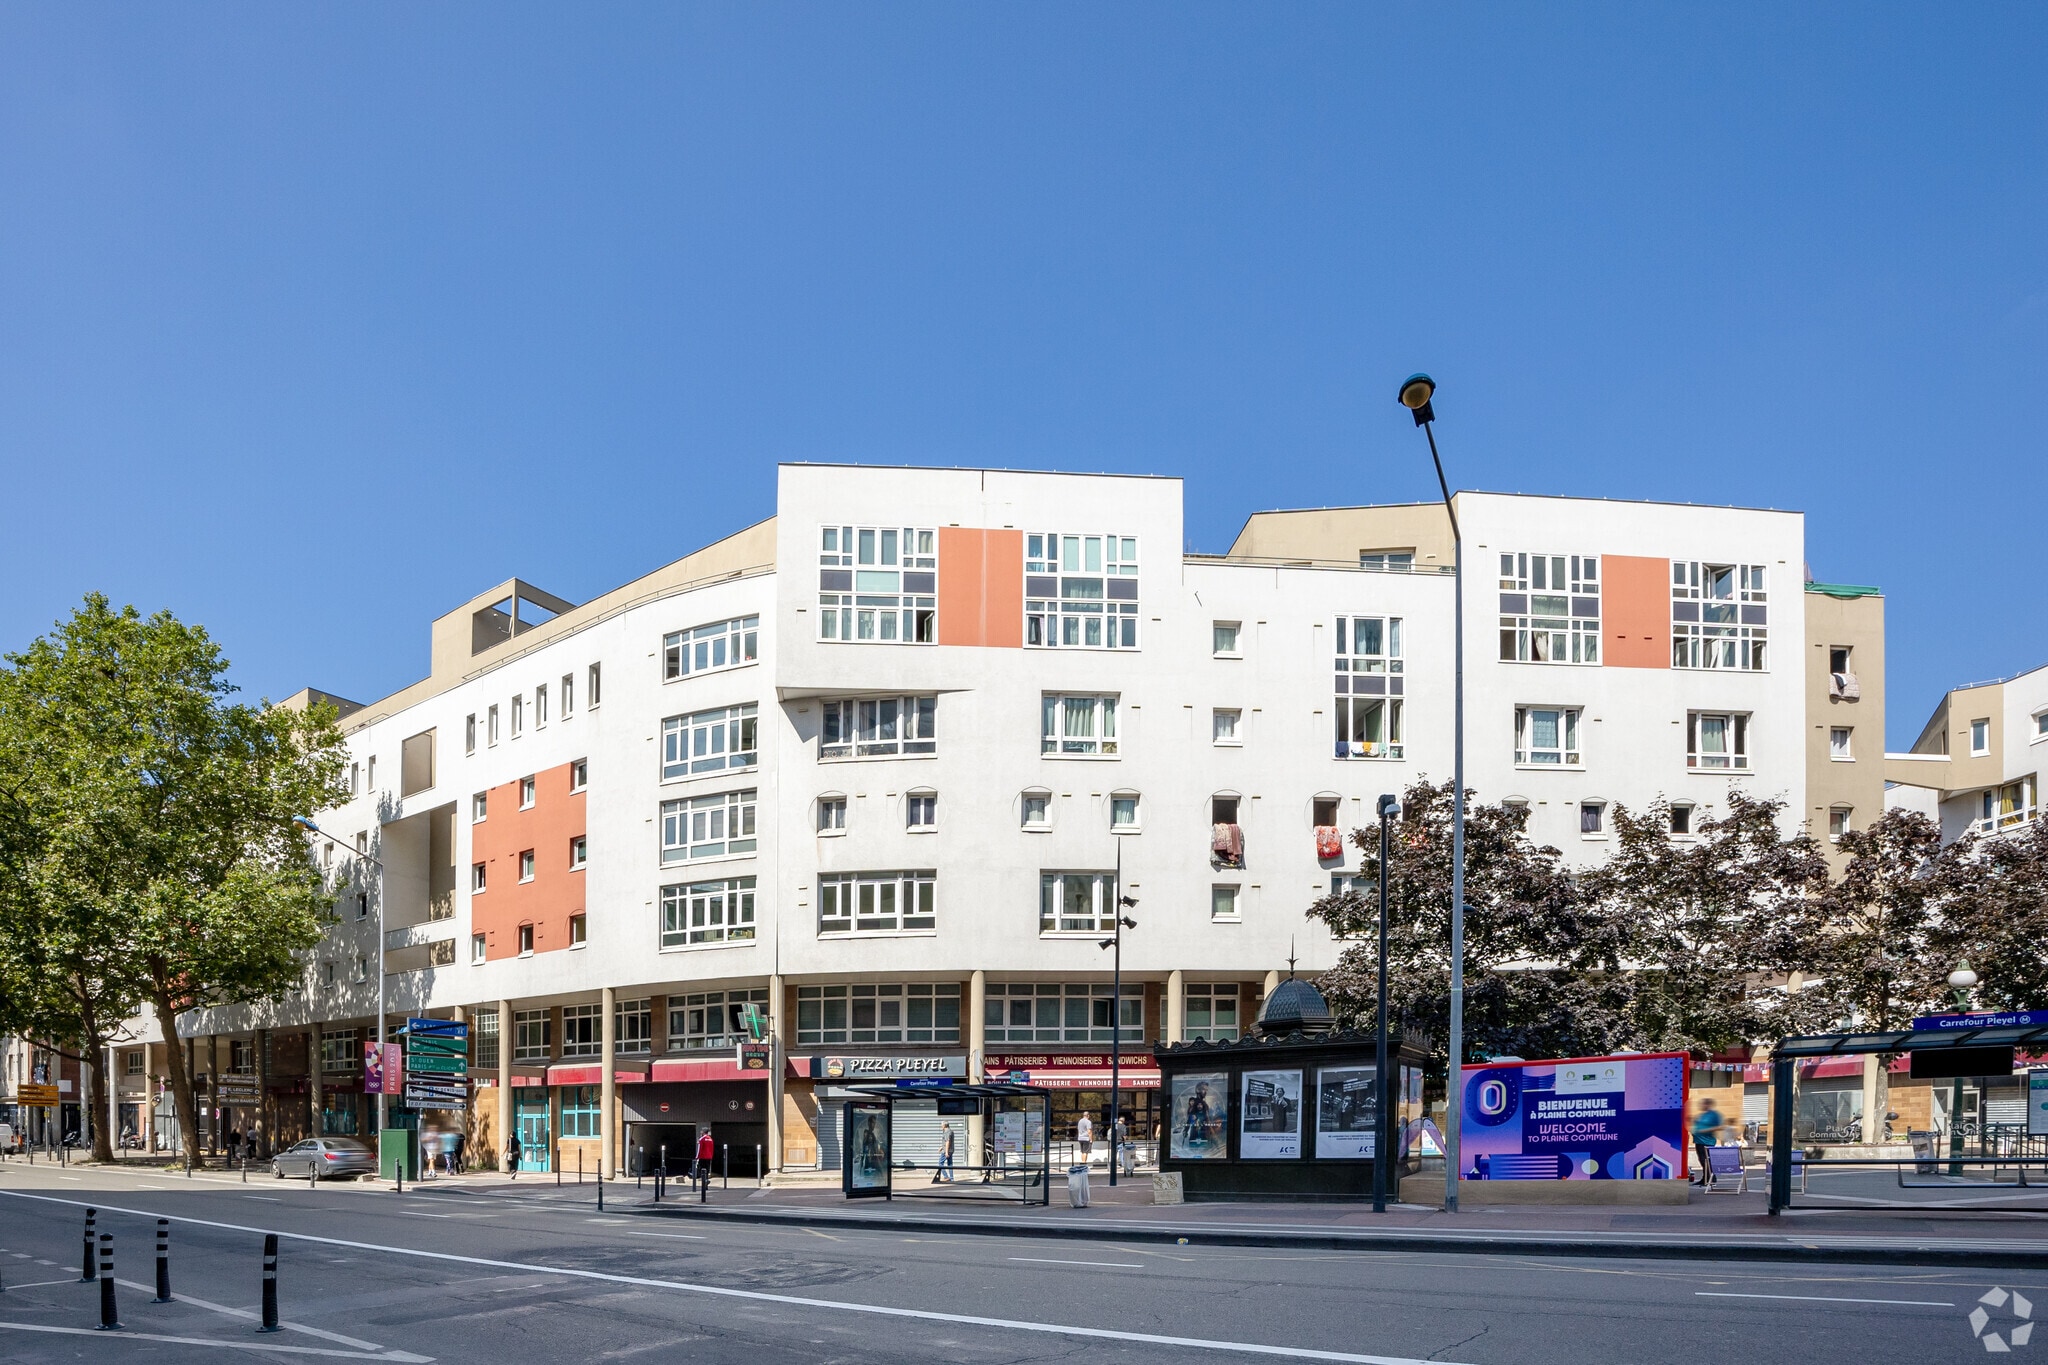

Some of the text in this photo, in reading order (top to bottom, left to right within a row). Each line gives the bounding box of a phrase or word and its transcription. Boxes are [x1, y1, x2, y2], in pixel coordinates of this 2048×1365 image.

[1939, 1018, 1984, 1027] Carrefour
[1986, 1016, 2016, 1025] Pleyel
[850, 1058, 893, 1073] PIZZA
[896, 1057, 948, 1073] PLEYEL
[984, 1055, 1148, 1065] AINS PÂTISSERIES VIENNOISERIES SNDWICHS
[1538, 1098, 1608, 1111] BIENVENUE
[1530, 1109, 1617, 1119] À PLAINE COMMUNE
[1539, 1122, 1607, 1134] WELCOME
[1528, 1133, 1618, 1143] TO PLAINE COMMUNE
